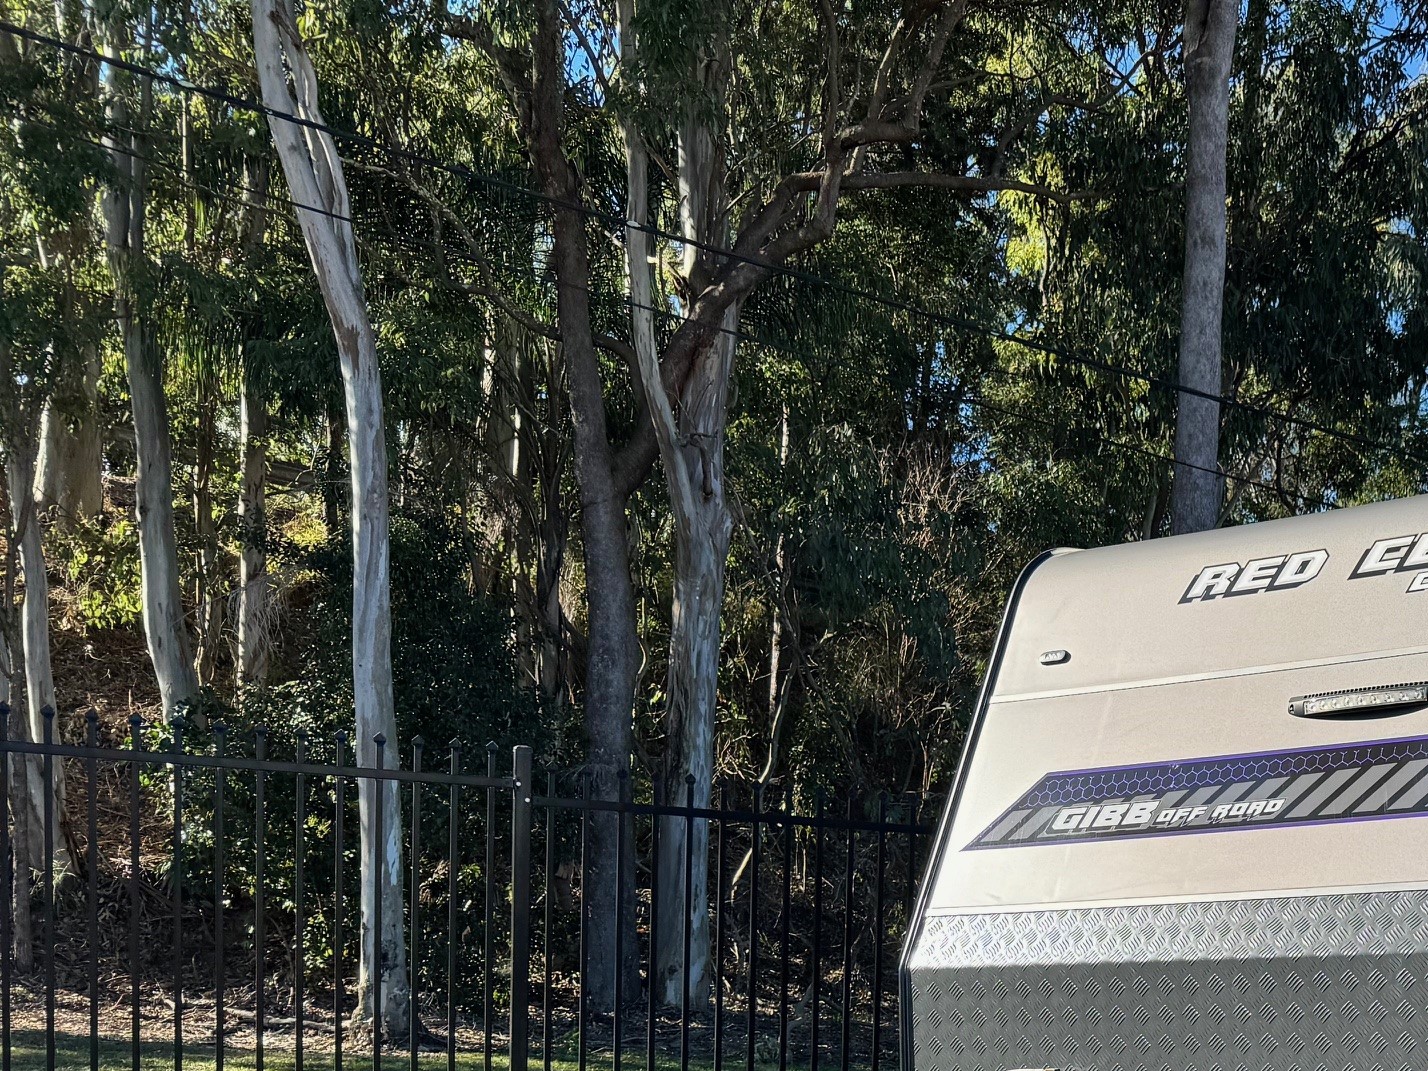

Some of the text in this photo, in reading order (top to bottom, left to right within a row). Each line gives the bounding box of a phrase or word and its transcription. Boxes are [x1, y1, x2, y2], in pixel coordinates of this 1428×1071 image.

[1178, 549, 1329, 604] RED
[1051, 798, 1286, 831] GIBB OFF ROAD
